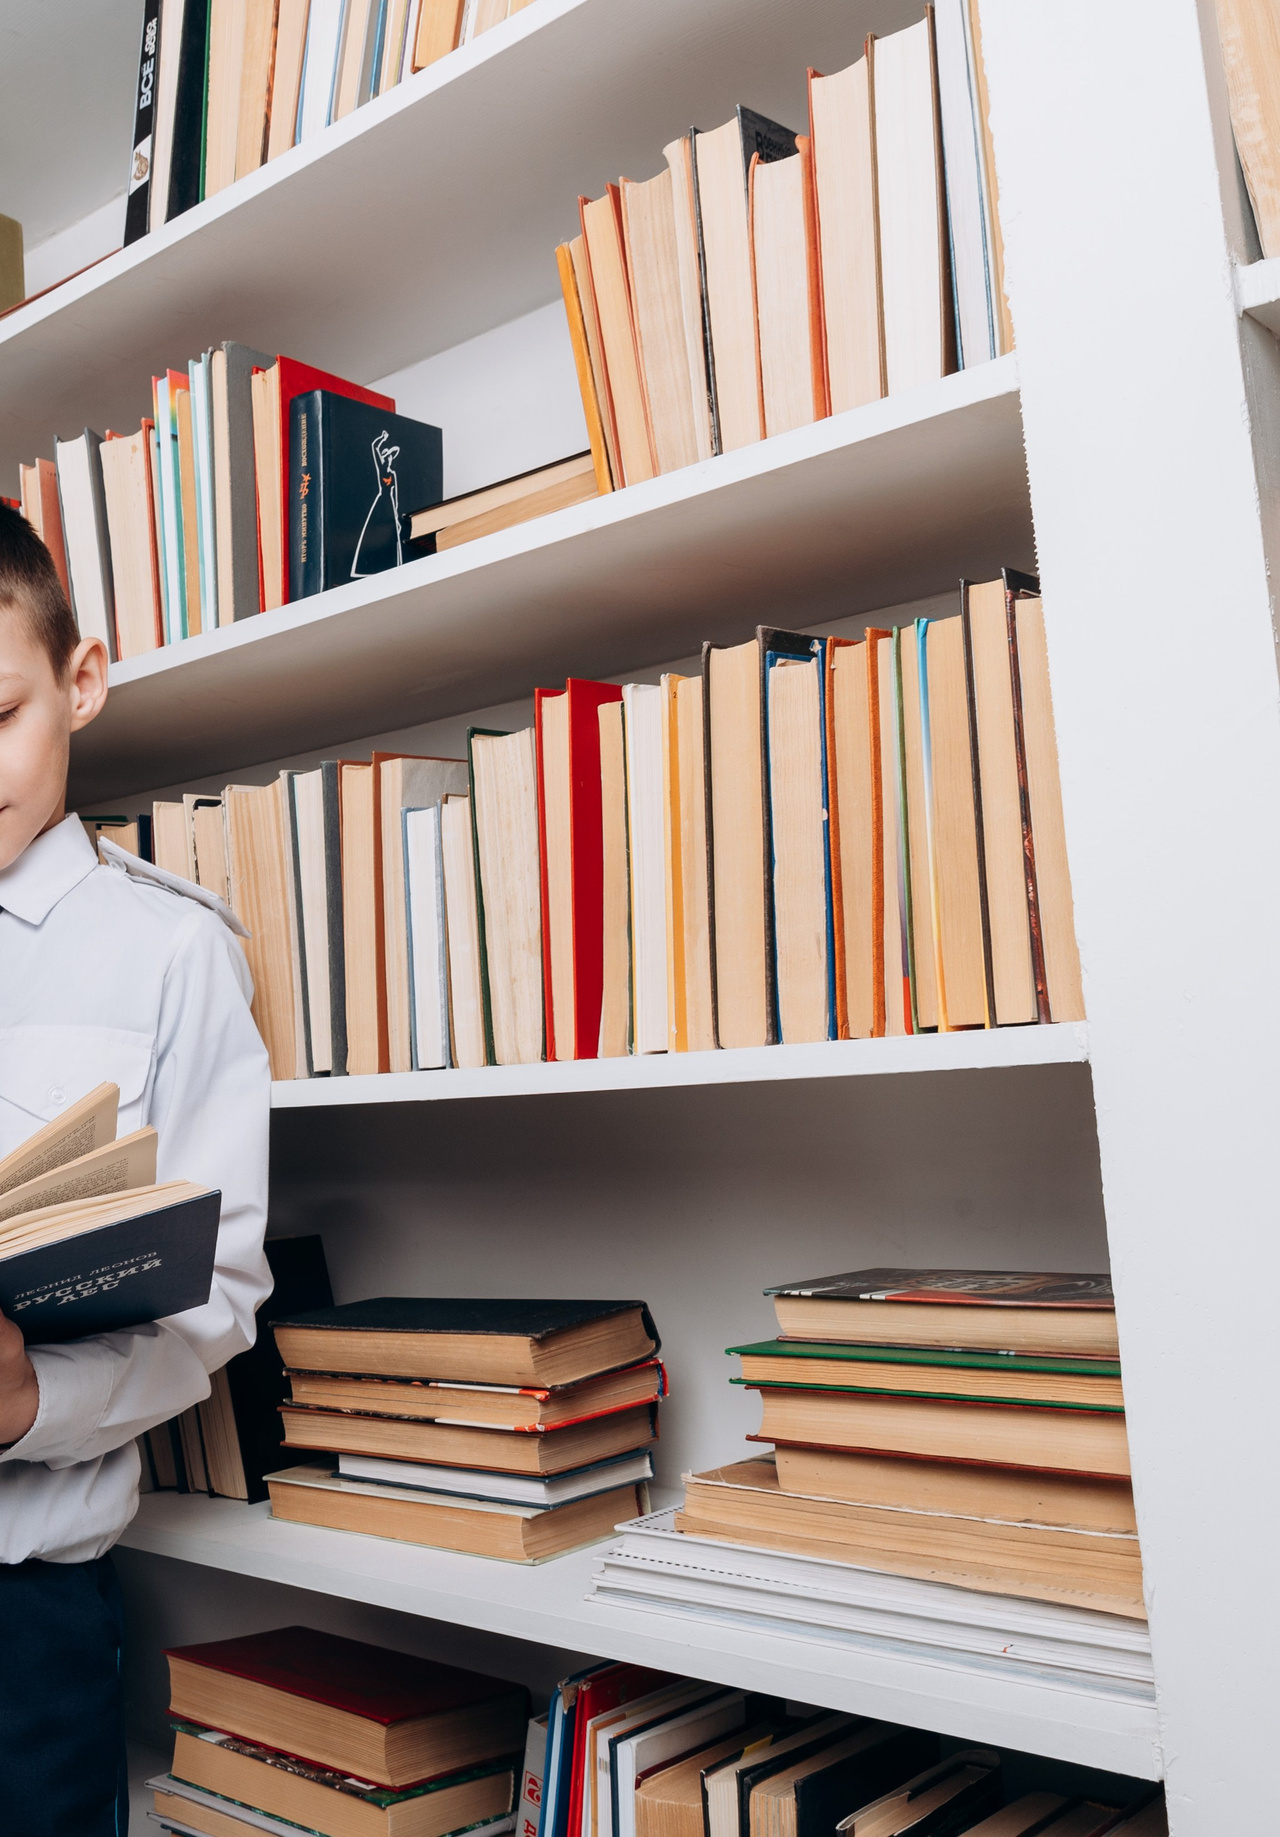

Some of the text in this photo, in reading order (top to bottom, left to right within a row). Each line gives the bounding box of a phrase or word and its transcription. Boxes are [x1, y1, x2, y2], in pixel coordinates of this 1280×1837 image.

[13, 1258, 163, 1312] РУССКИЙ
[14, 1251, 158, 1300] ЛЕОНИД ЛЕОНОВ
[56, 1280, 121, 1306] ЛЕС
